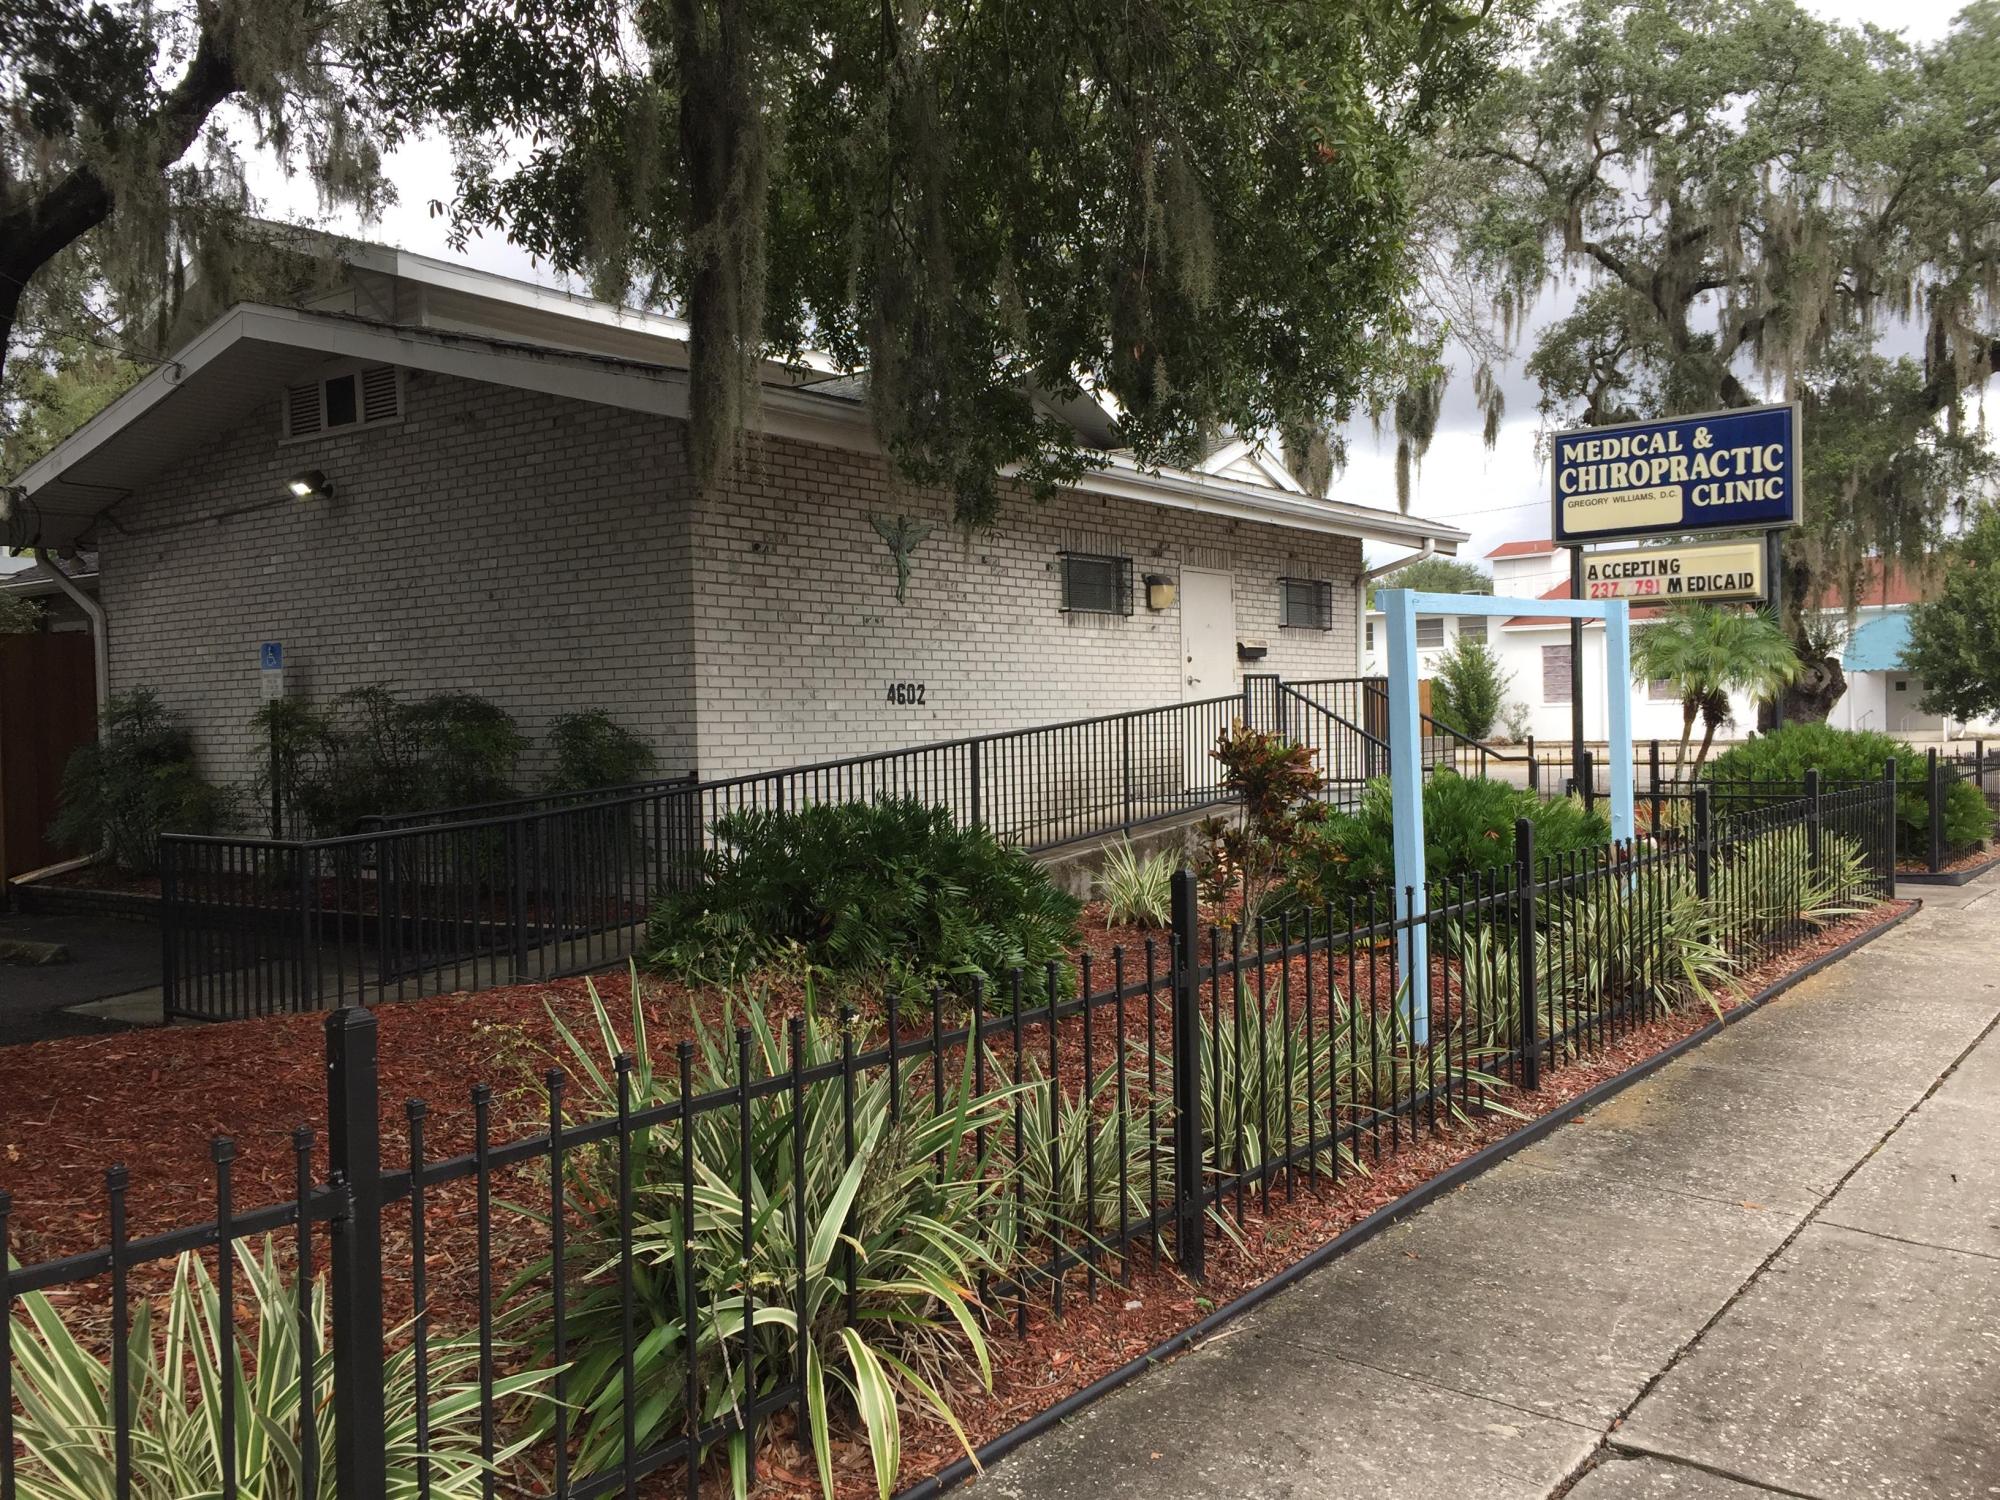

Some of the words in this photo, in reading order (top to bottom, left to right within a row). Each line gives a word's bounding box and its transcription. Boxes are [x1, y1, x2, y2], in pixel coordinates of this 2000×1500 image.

[1562, 430, 1683, 465] MEDICAL
[1692, 426, 1714, 449] &
[1559, 444, 1784, 494] CHIROPRACTIC
[1568, 497, 1609, 509] GREGORY
[1612, 492, 1657, 504] WILLIAMS,
[1660, 490, 1678, 499] D.C.
[1691, 476, 1784, 507] CLINIC
[1587, 558, 1681, 580] ACCEPTING
[1591, 581, 1620, 599] 237
[1667, 572, 1754, 594] MEDICAID
[887, 683, 926, 705] 4602
